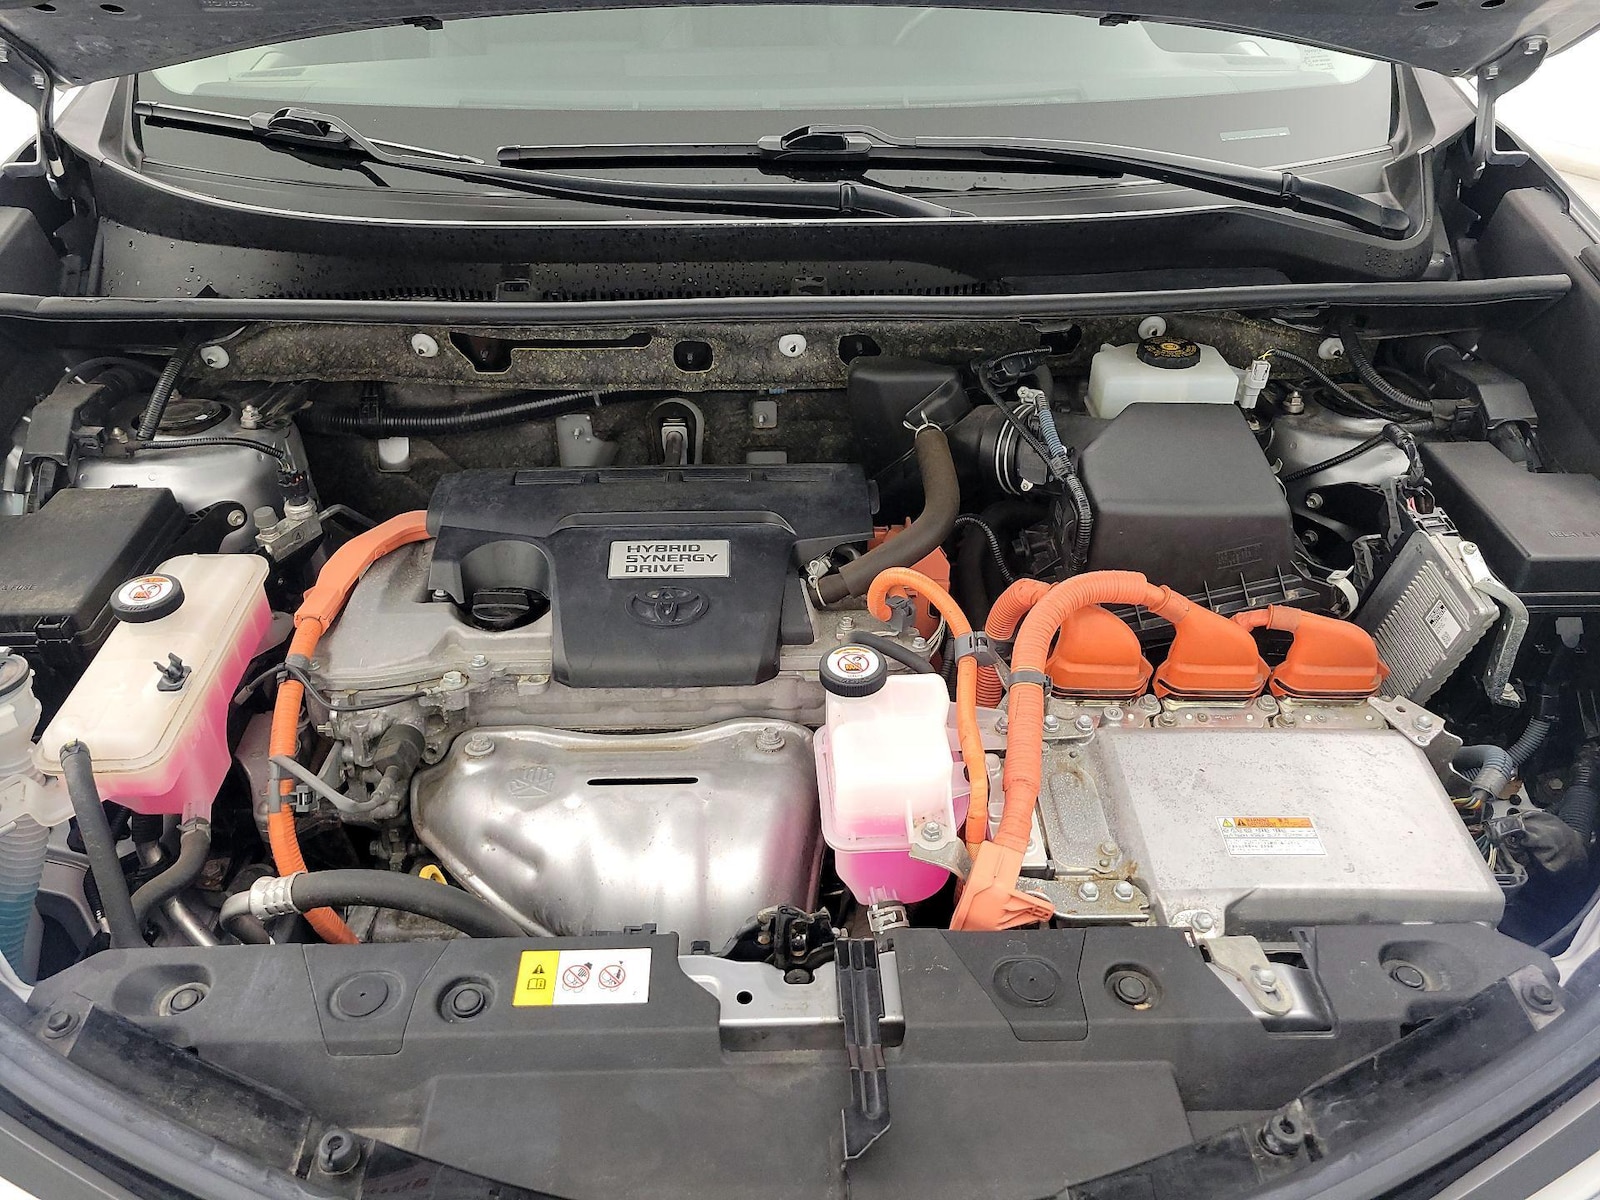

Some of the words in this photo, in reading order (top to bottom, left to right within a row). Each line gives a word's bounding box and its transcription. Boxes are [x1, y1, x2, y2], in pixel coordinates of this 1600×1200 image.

[627, 544, 701, 553] HYBRID
[625, 553, 718, 562] SYNERGY
[625, 564, 685, 573] DRIVE
